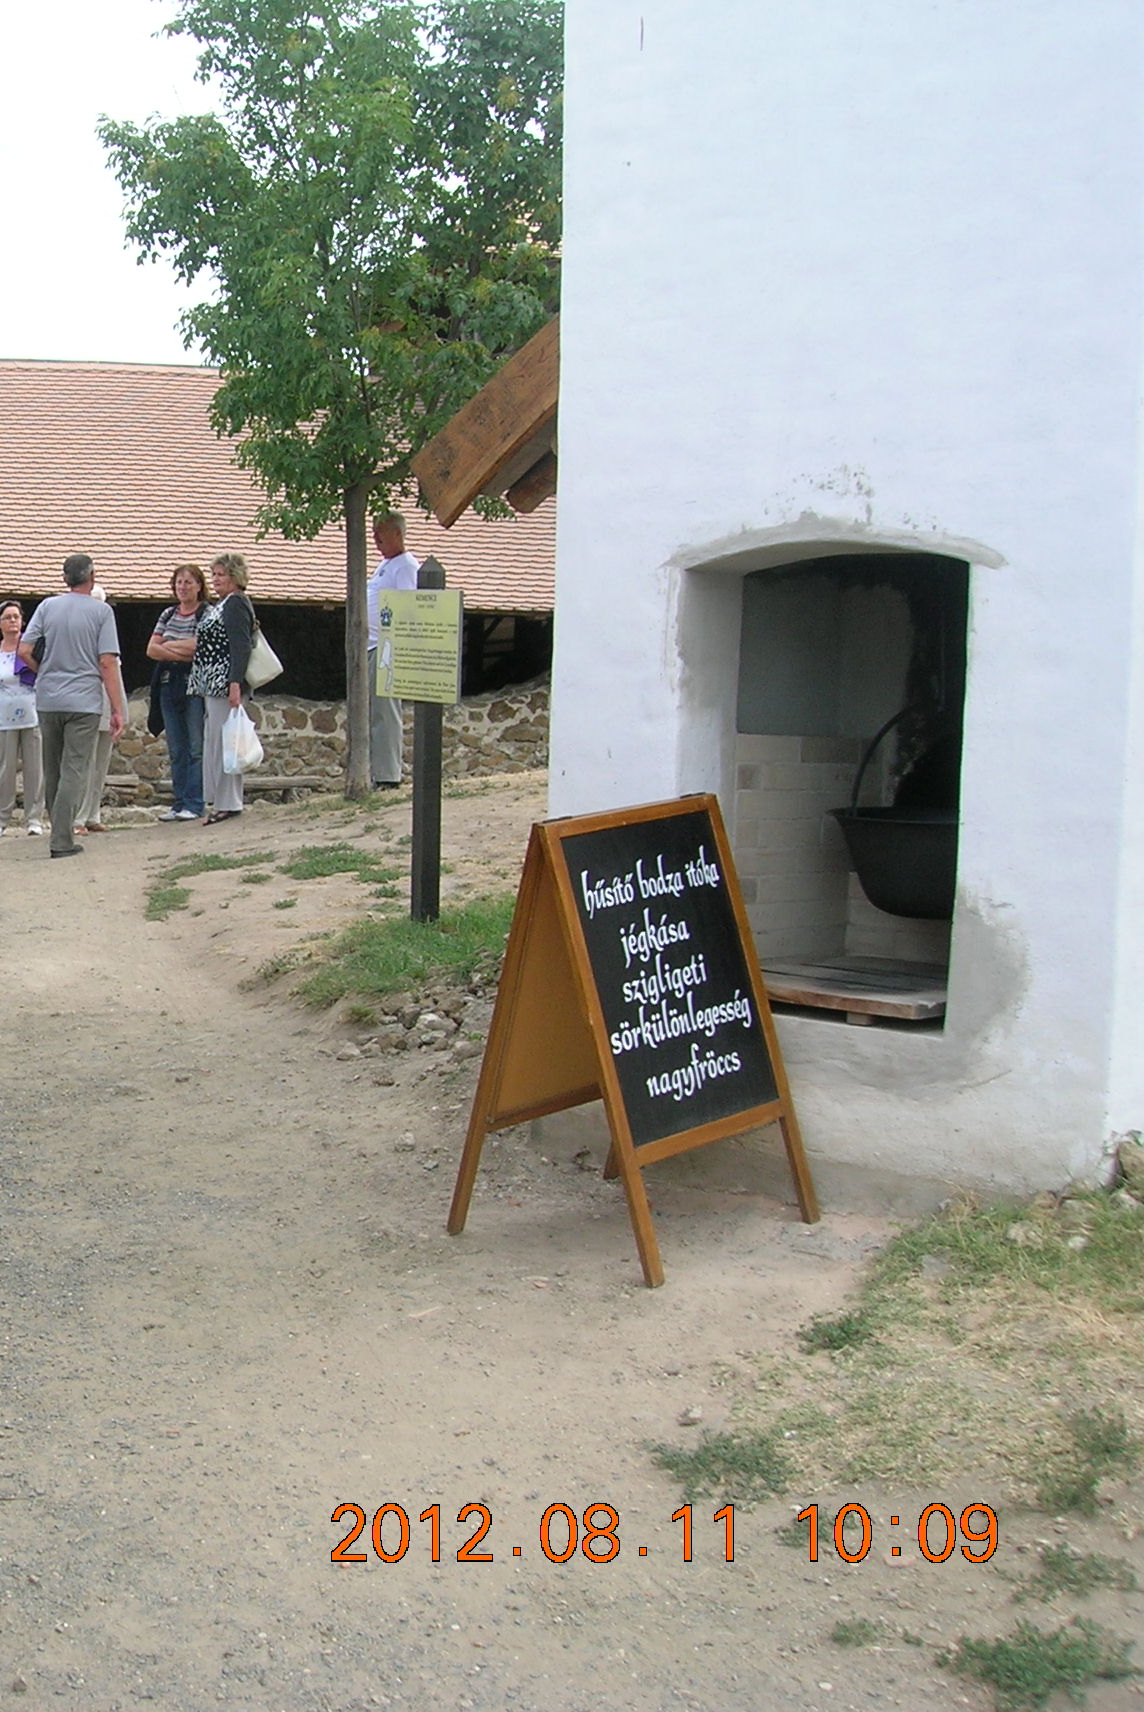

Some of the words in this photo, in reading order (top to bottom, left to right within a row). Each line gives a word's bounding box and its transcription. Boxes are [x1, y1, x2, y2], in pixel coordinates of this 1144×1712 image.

[581, 869, 634, 919] hűsítő
[636, 854, 684, 899] bodza
[685, 844, 720, 888] itóka
[619, 907, 690, 968] jégkása
[622, 953, 707, 1005] szigligeti
[610, 989, 752, 1055] sörkülönlegesség
[646, 1042, 742, 1102] nagyfröccs
